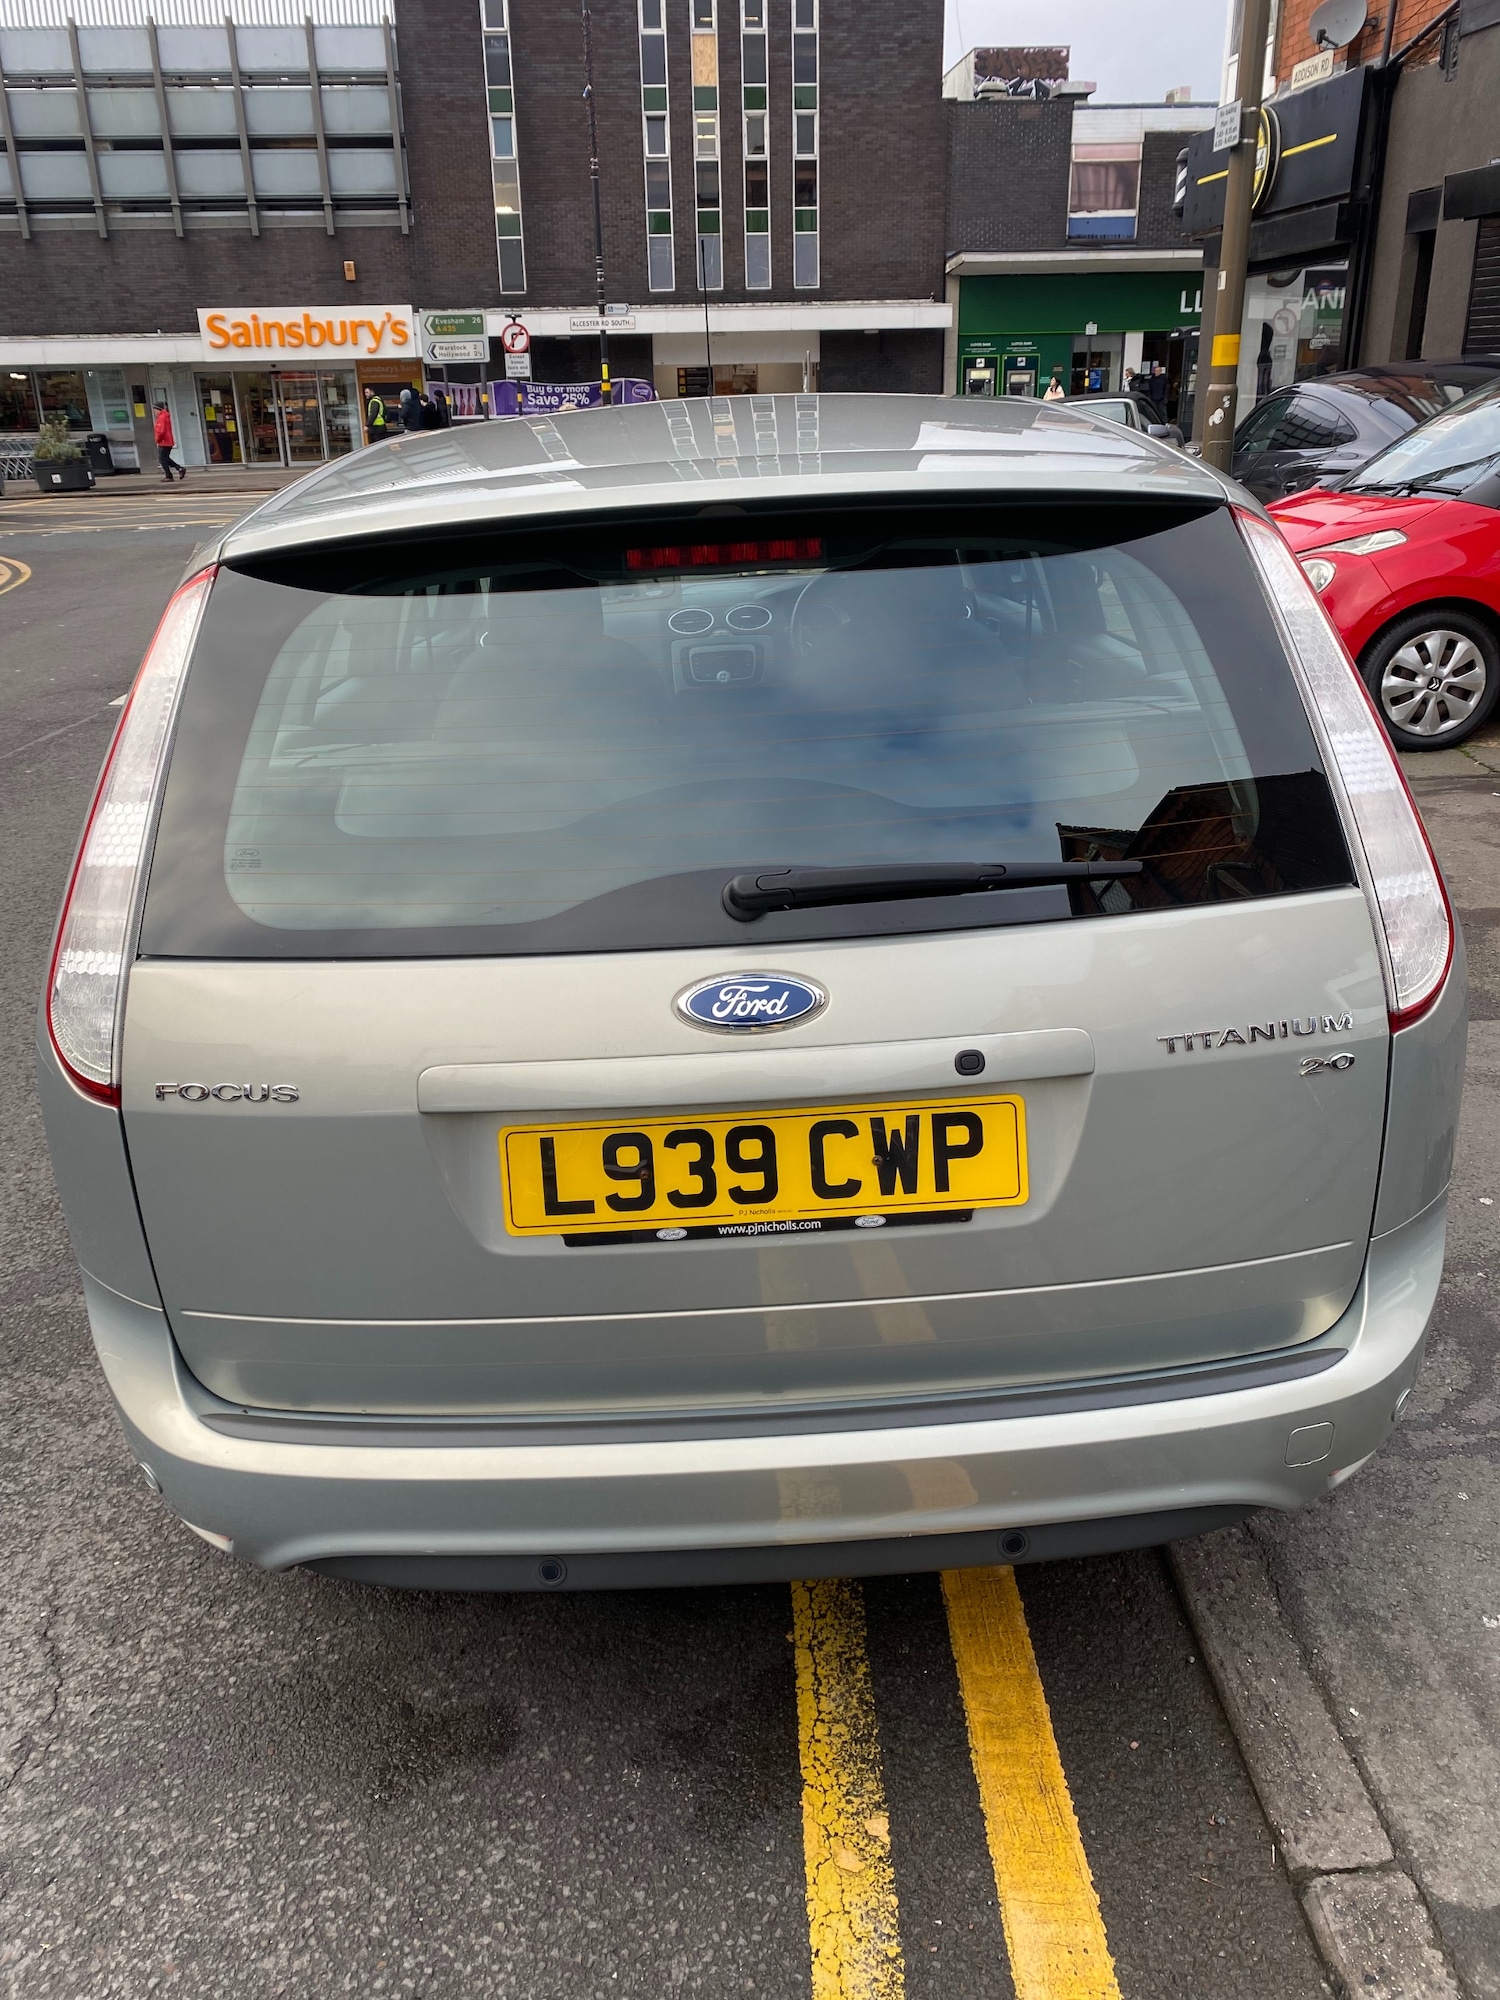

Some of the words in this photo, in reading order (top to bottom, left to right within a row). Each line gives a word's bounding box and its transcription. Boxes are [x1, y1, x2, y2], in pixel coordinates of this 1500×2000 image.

[1294, 62, 1319, 84] ADDISON
[1320, 58, 1330, 72] RD
[435, 317, 465, 325] Evesham
[471, 316, 481, 324] 26
[572, 319, 600, 328] ALCESTER
[611, 319, 630, 327] SOUTH
[206, 312, 409, 353] Sainsbury's
[438, 351, 470, 359] Hollywood
[526, 385, 545, 395] Buy
[565, 385, 590, 393] more
[527, 393, 559, 406] Save
[561, 393, 590, 405] 25%
[711, 985, 790, 1018] Ford
[1157, 1011, 1354, 1054] TITANIUM
[155, 1083, 300, 1103] FOCUS
[539, 1125, 780, 1217] L939
[808, 1111, 985, 1200] CWP
[749, 1207, 776, 1215] Nicholls
[718, 1219, 822, 1236] www.pjnicholls.com
[860, 1217, 883, 1226] Ford
[662, 1231, 683, 1239] Ford
